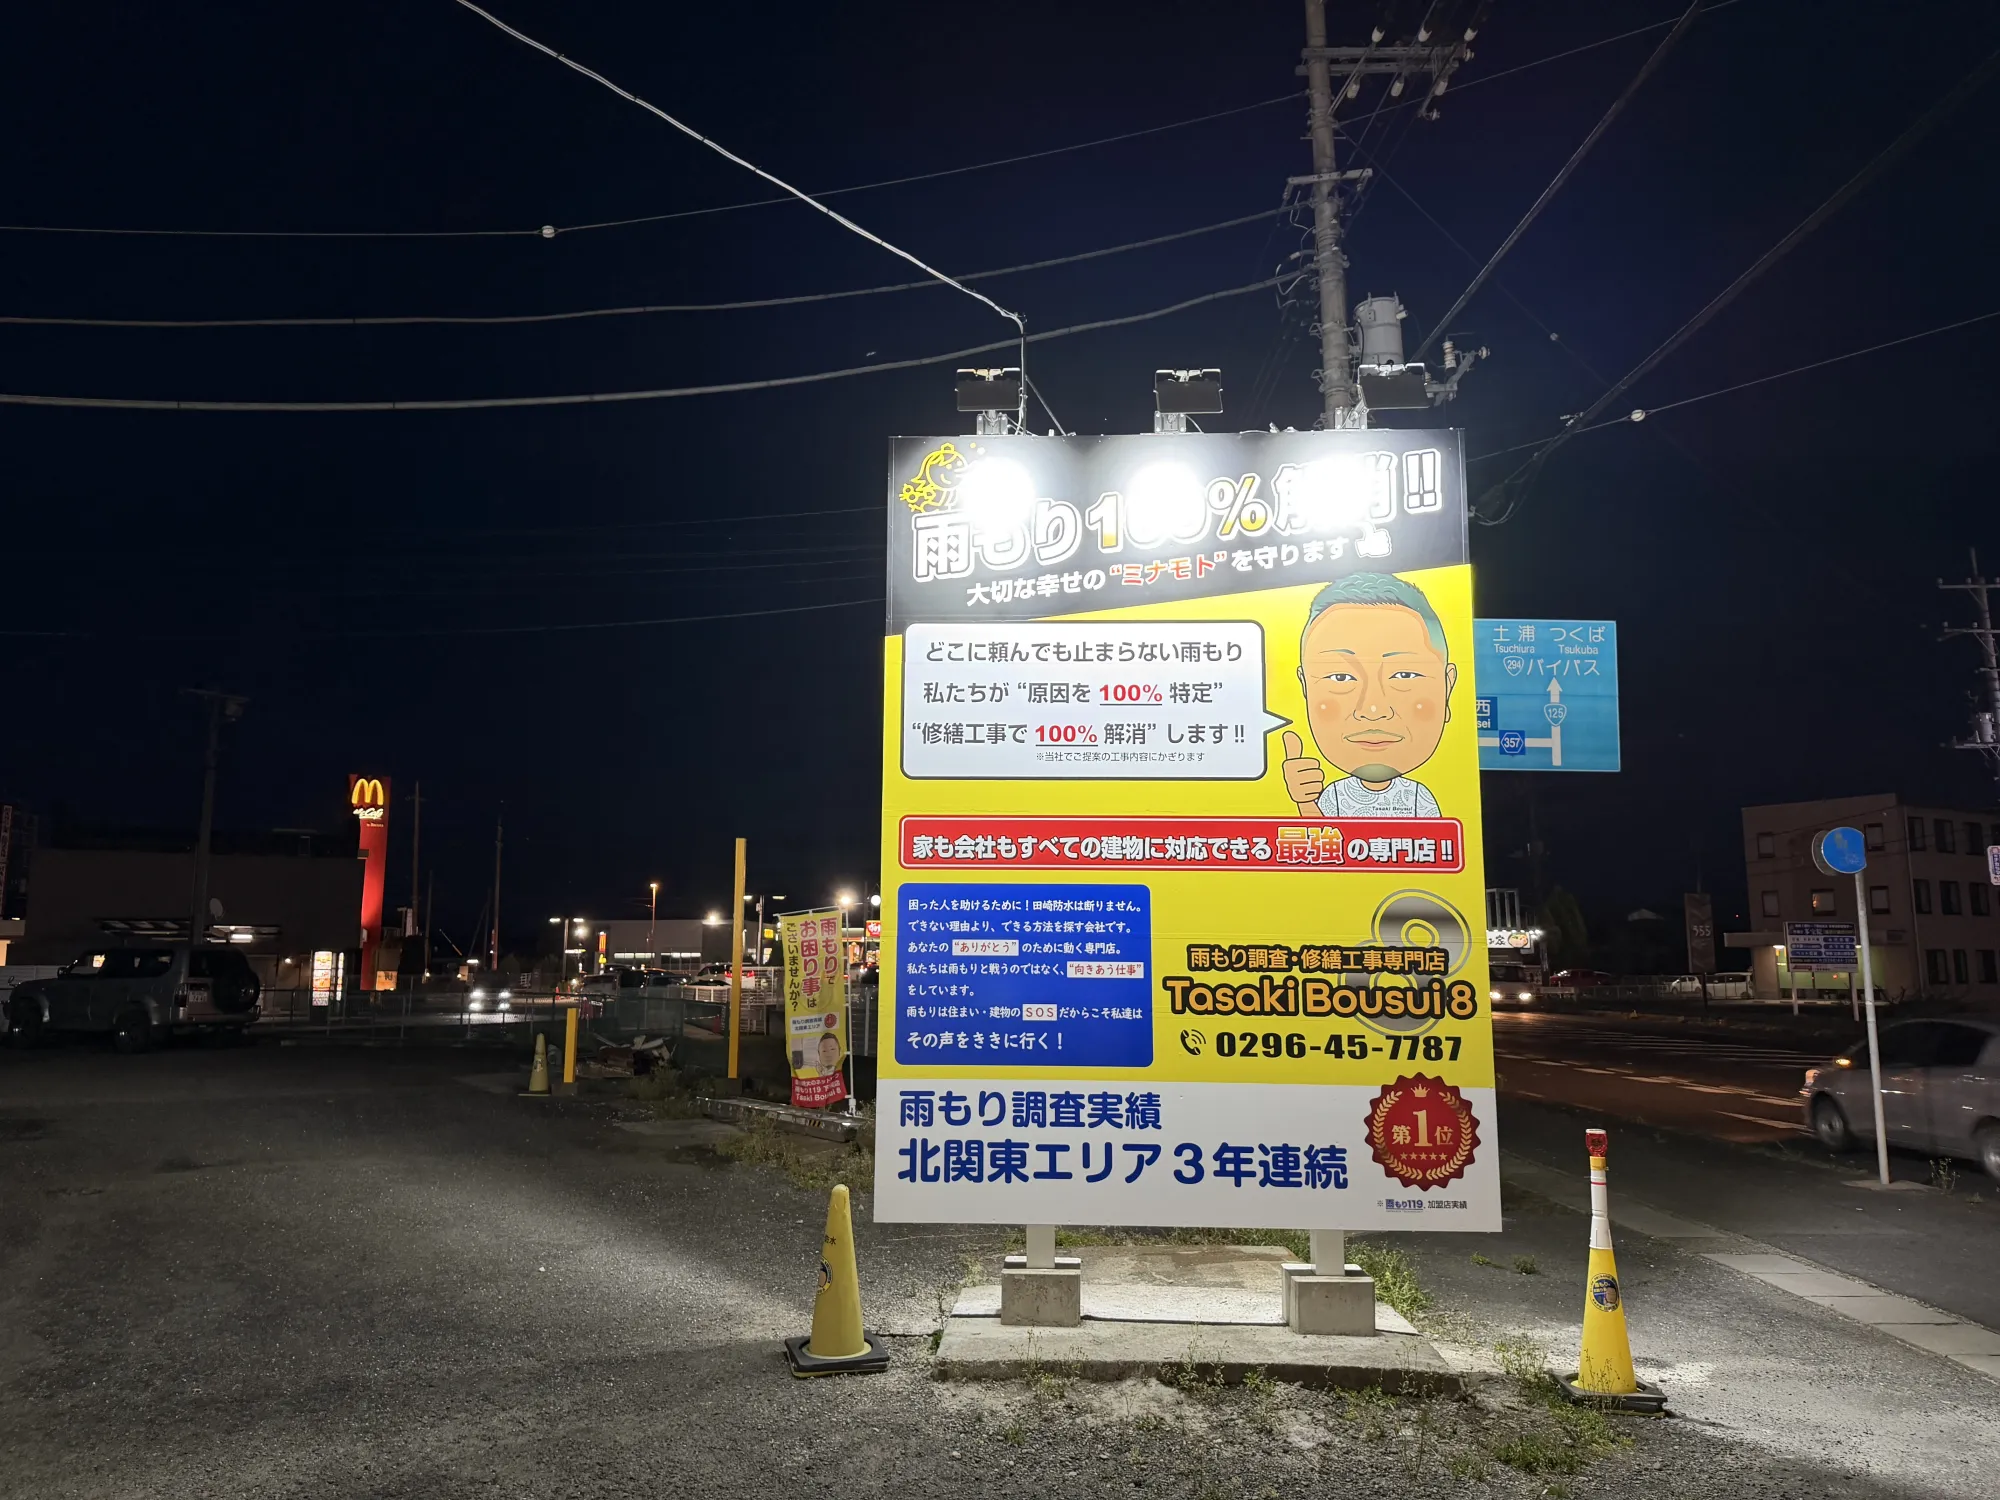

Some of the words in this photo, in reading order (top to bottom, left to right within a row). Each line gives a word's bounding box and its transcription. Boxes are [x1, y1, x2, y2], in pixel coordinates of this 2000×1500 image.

[1493, 625, 1536, 642] 土浦
[1549, 626, 1606, 643] つくば
[925, 641, 1243, 663] どこに頼んでも止まらない雨もり
[1494, 644, 1535, 654] Tsuchiura
[1558, 645, 1599, 655] Tsukuba
[1507, 659, 1522, 670] 294
[1527, 659, 1600, 676] バイパス
[1548, 708, 1564, 718] 125
[1504, 738, 1521, 748] 357
[820, 917, 839, 985] 雨もりで
[1190, 947, 1446, 972] 雨もり調査・修繕工事専門店
[800, 920, 821, 1008] お困り事は
[907, 984, 975, 997] をしています。
[1165, 977, 1297, 1014] Tasaki
[1305, 979, 1443, 1018] Bousui
[1450, 982, 1475, 1018] 8
[1215, 1032, 1462, 1062] 0296-45-7787
[899, 1090, 1163, 1130] 雨もり調査実績
